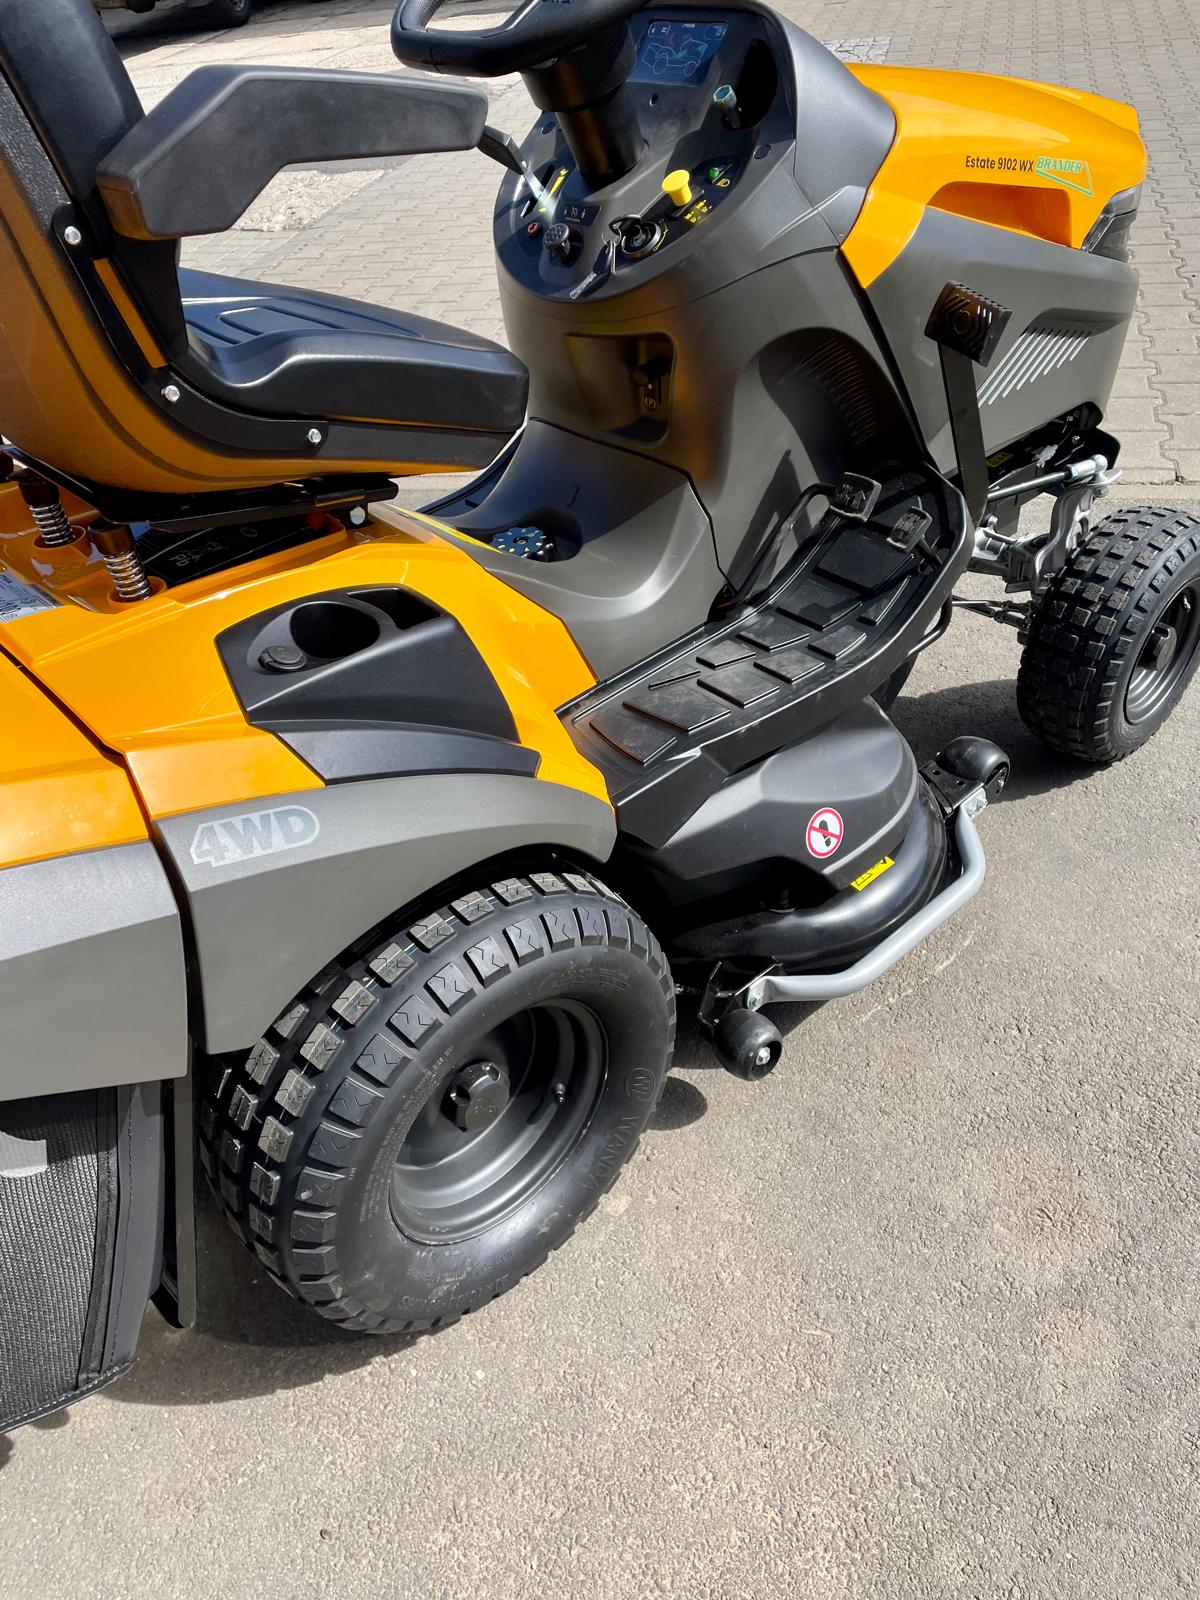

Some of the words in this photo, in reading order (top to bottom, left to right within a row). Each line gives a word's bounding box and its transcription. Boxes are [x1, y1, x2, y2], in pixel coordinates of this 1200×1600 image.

[965, 155, 996, 169] Estate
[997, 157, 1017, 171] 9102
[1019, 160, 1034, 173] WX
[1036, 156, 1083, 173] BRANDER
[191, 805, 319, 867] 4WD
[579, 1115, 642, 1190] WANDA
